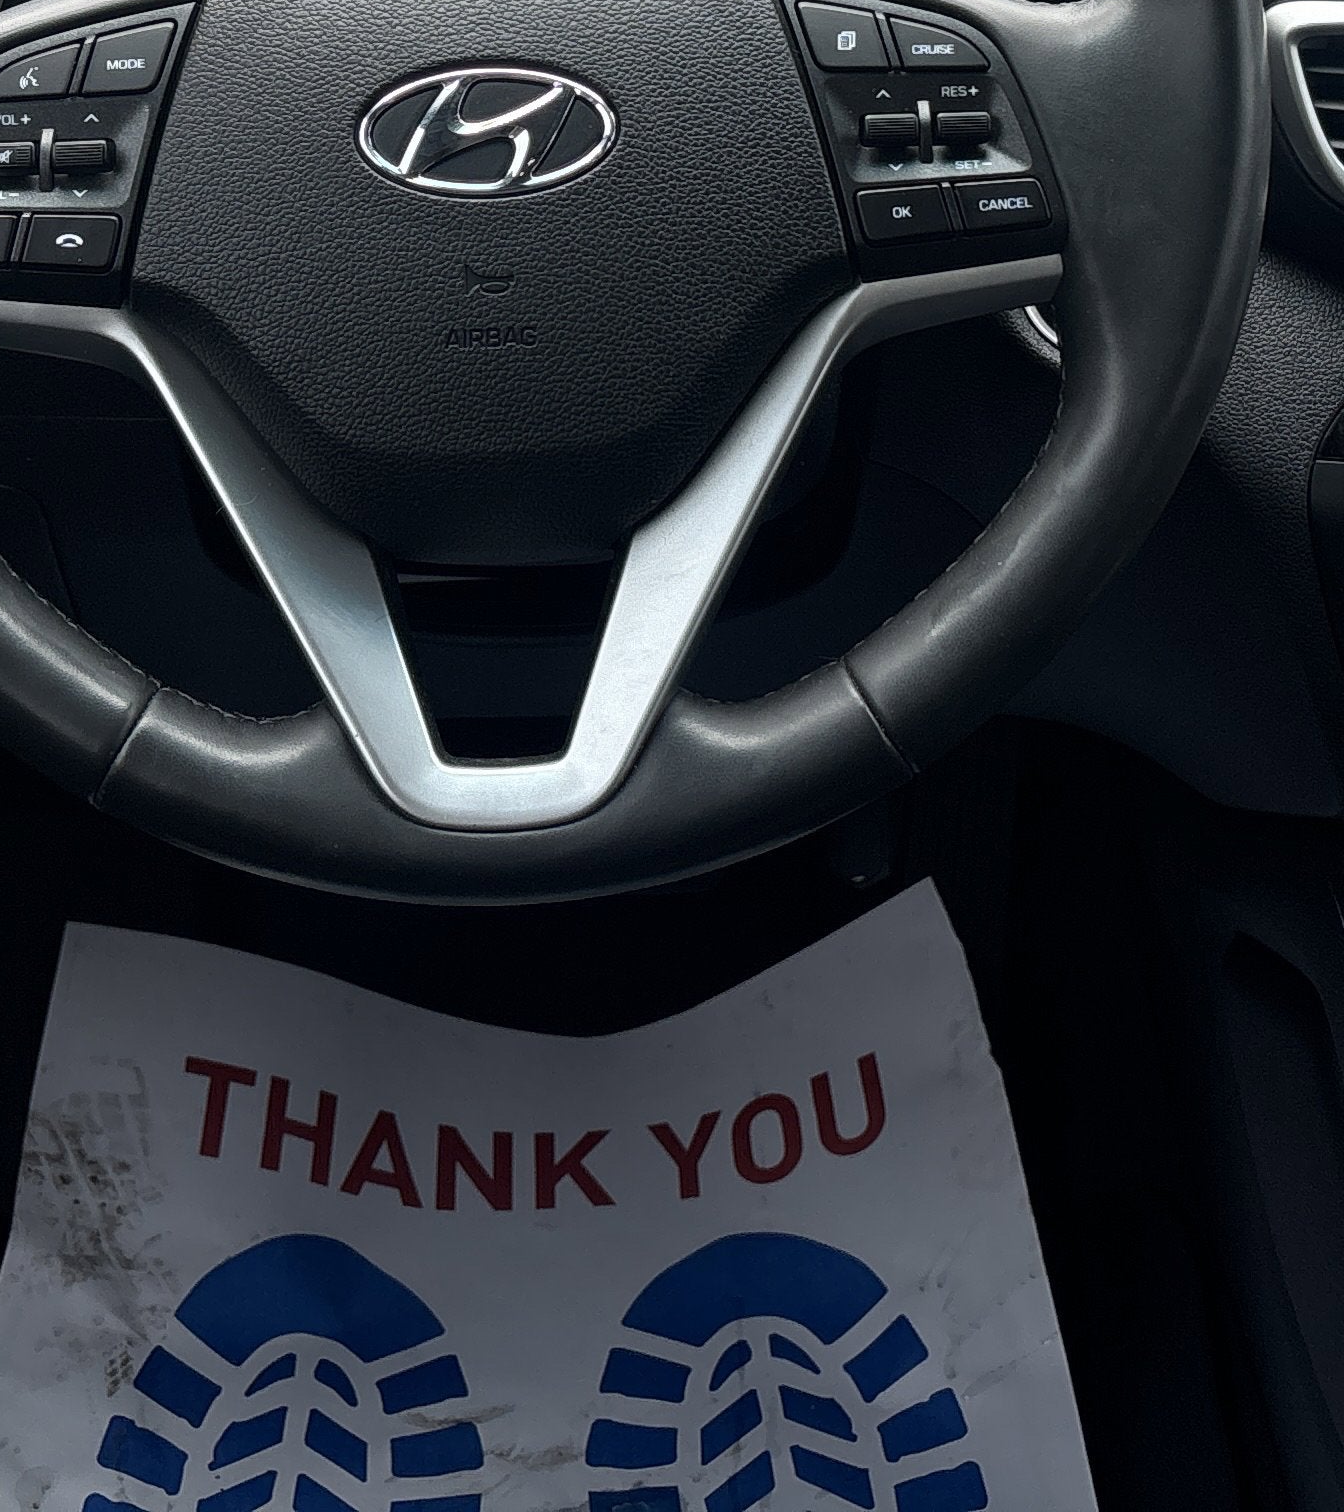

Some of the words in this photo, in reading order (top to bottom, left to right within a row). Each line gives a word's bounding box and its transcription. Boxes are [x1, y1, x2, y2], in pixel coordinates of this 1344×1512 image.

[912, 44, 955, 55] CRUISE
[106, 58, 145, 70] MODE
[978, 196, 1033, 212] CANCEL
[892, 206, 912, 218] OK
[445, 327, 539, 350] AIRBAG
[185, 1056, 615, 1211] THANK
[648, 1052, 886, 1201] YOU
